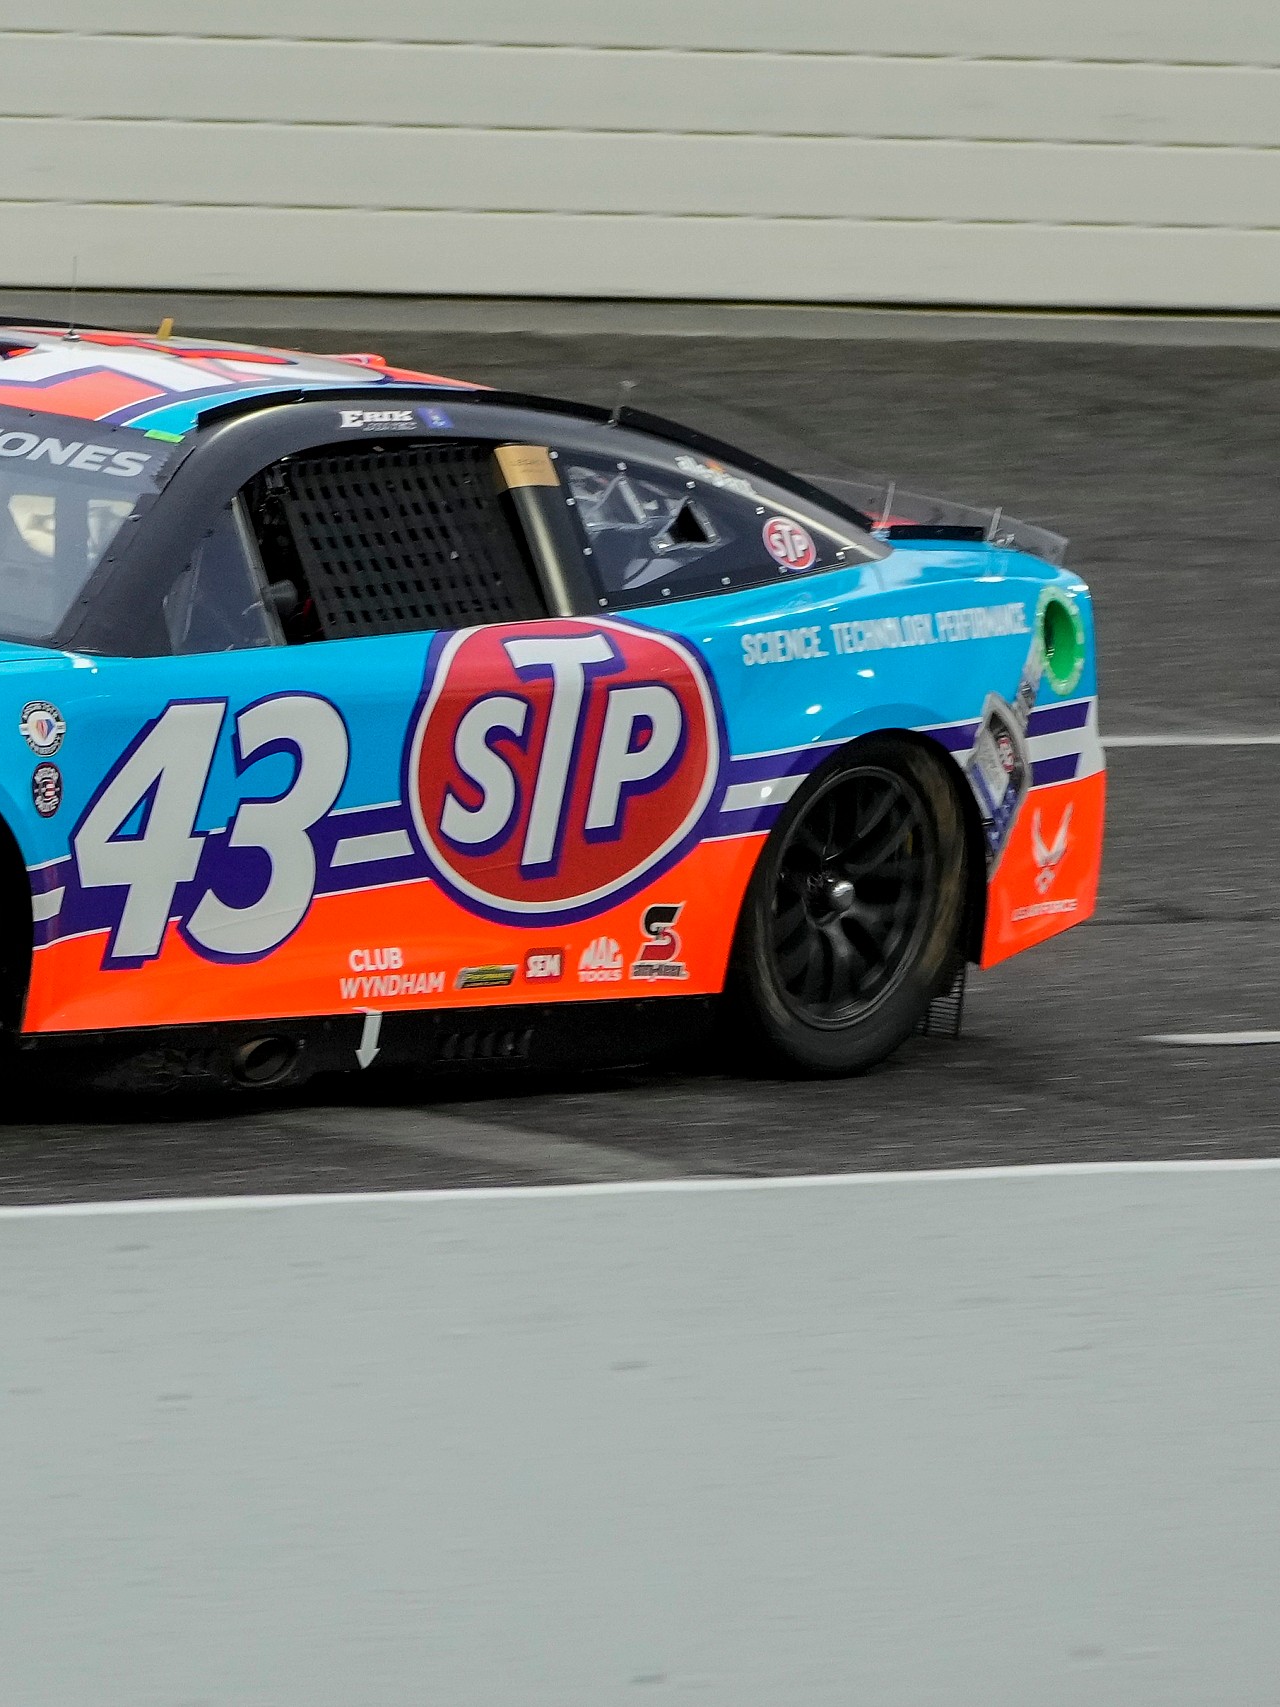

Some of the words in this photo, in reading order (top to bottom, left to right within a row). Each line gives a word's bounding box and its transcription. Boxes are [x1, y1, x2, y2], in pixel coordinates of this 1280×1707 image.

[339, 410, 413, 428] ERIK
[770, 523, 809, 562] STP
[440, 634, 682, 866] STP
[73, 694, 350, 959] 43
[349, 947, 403, 972] CLUB
[339, 971, 446, 1000] WYNDHAM
[579, 970, 623, 982] TOOLS
